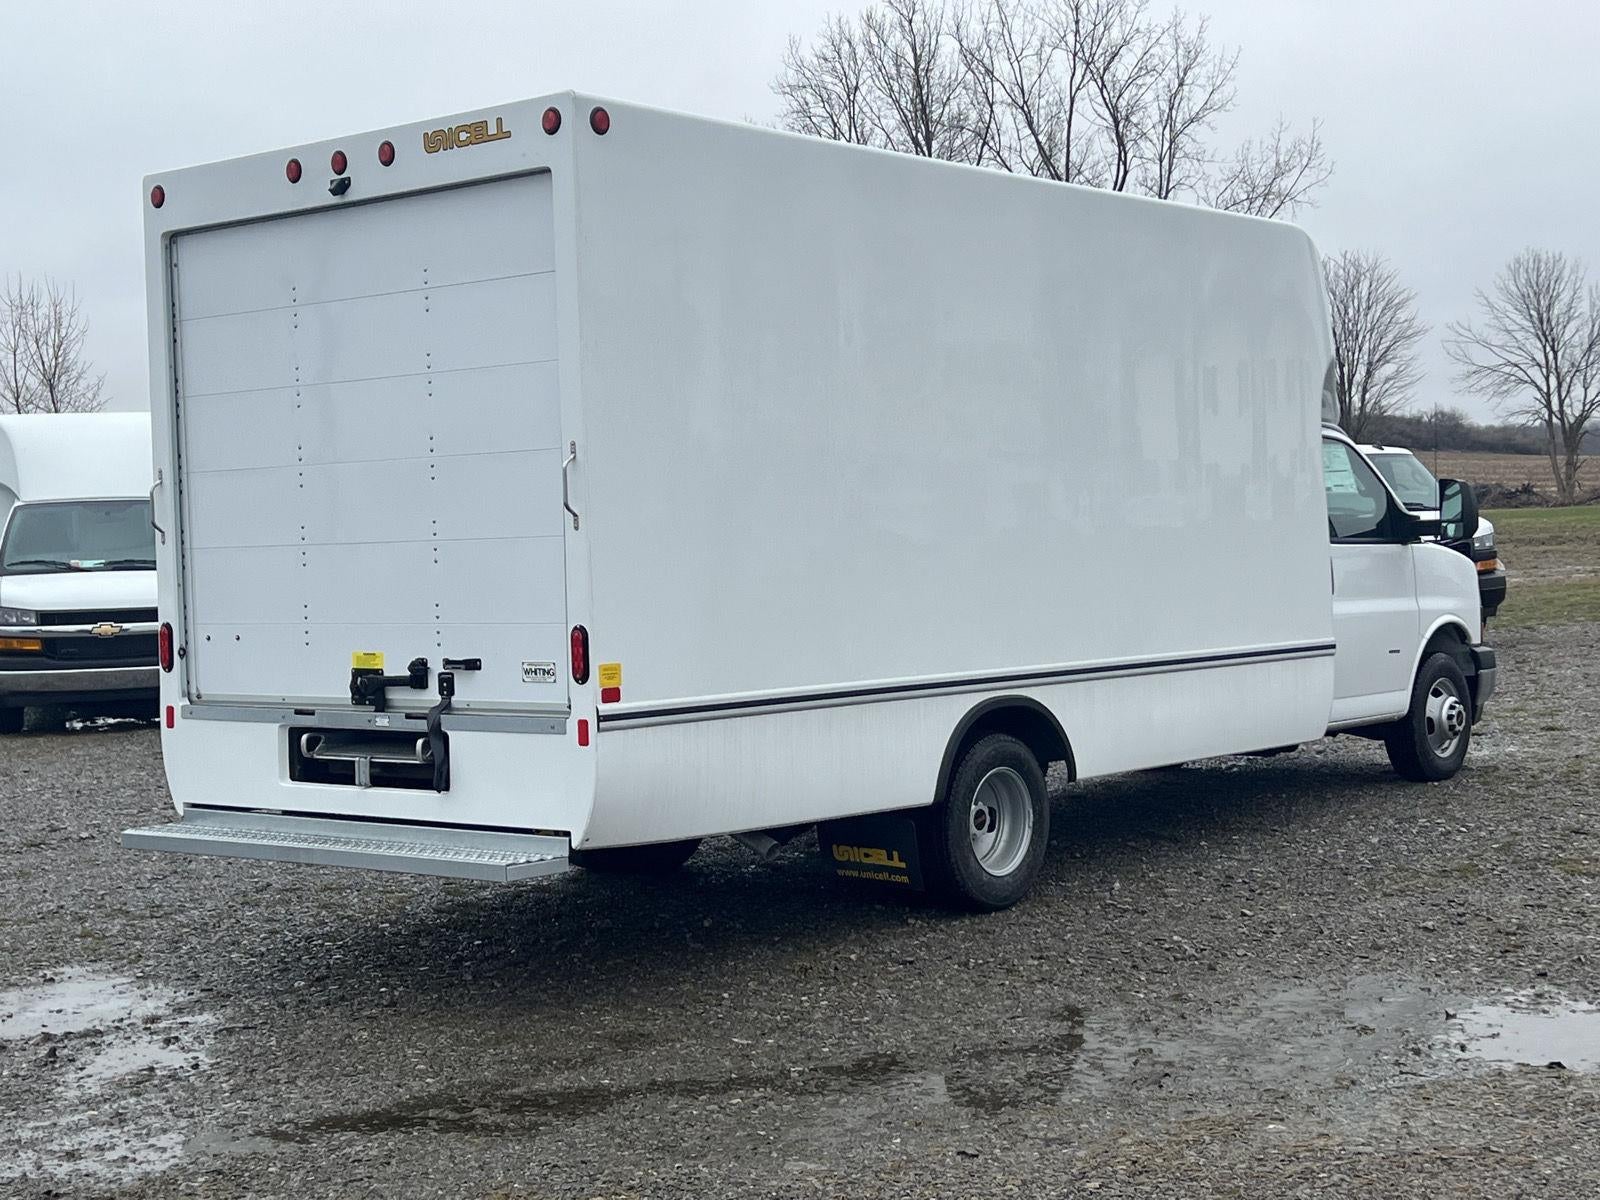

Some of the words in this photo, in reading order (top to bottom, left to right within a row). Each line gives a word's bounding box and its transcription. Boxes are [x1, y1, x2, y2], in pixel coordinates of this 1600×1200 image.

[423, 117, 512, 154] UNICELL
[523, 667, 555, 677] WHITING
[832, 844, 907, 869] UNICELL
[837, 869, 909, 884] www.unicell.com
